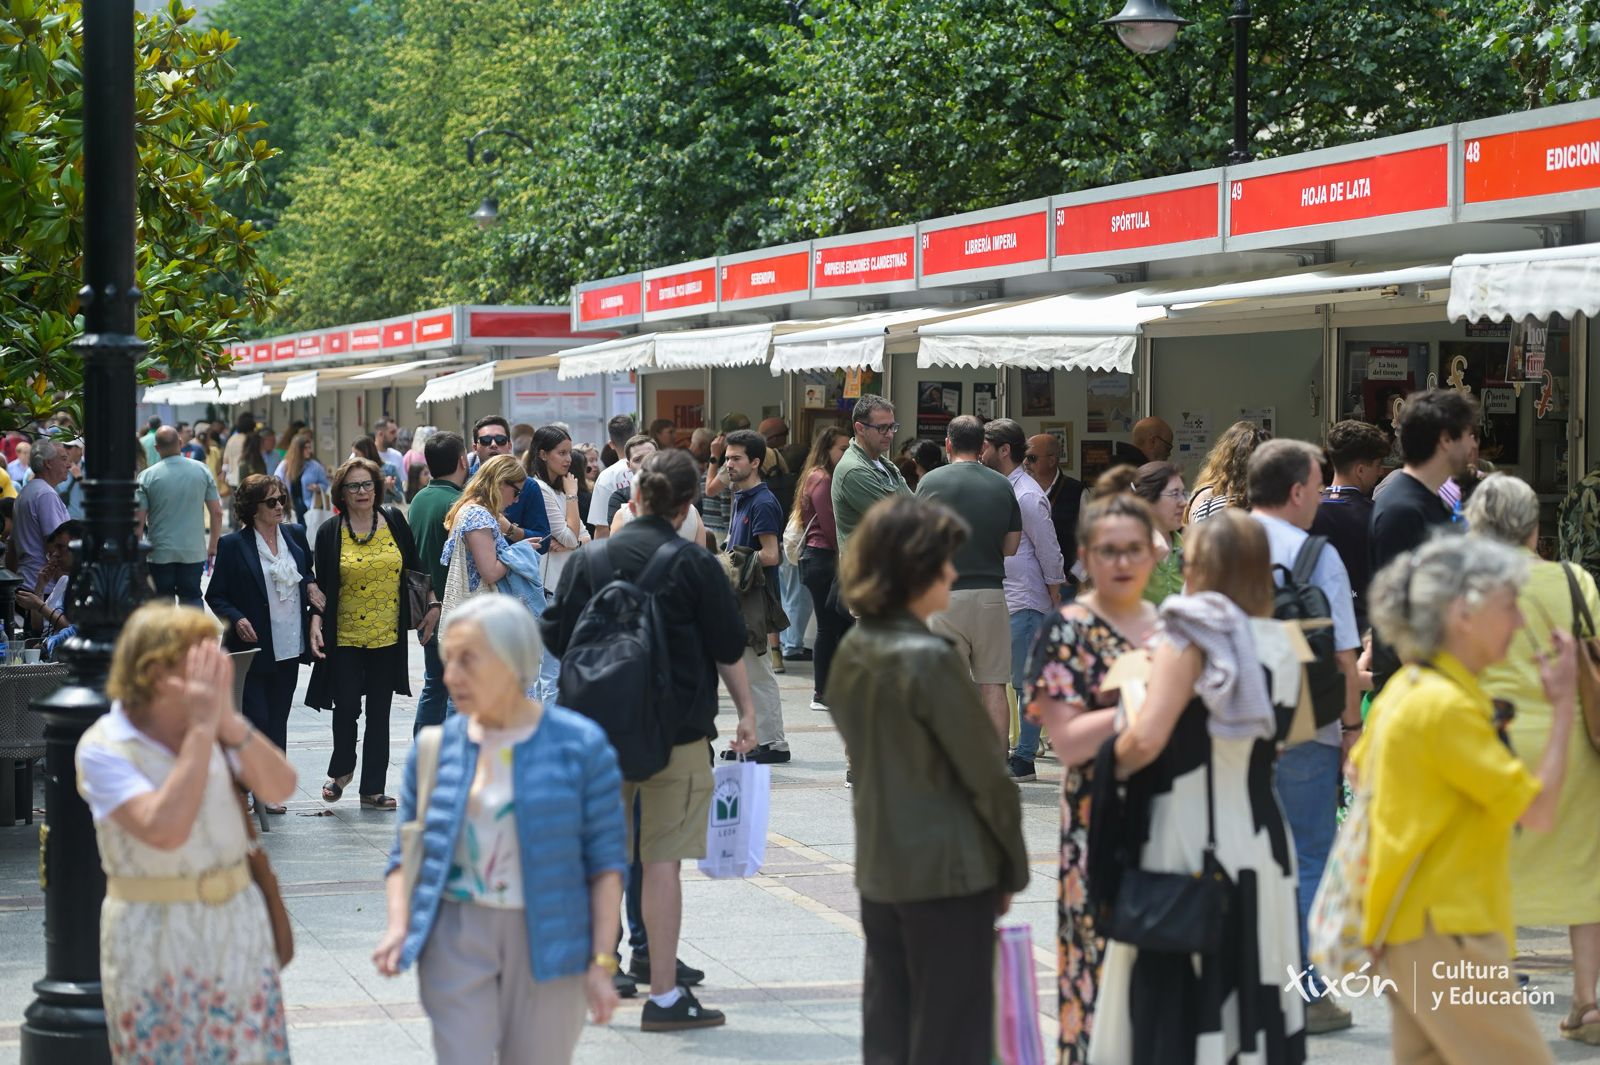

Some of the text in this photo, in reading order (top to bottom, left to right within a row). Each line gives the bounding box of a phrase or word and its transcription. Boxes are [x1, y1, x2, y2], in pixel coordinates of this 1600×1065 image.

[1466, 141, 1480, 162] 48
[1232, 183, 1242, 200] 49
[1301, 178, 1371, 207] HOJA DE LATA
[1057, 210, 1065, 226] 50
[1111, 211, 1150, 232] SPÓRTULA
[923, 234, 930, 249] 51
[965, 233, 1017, 255] LIBRERÍA IMPERIA
[845, 258, 871, 274] EDICIONES
[870, 252, 908, 271] CLANDESTINAS
[1387, 362, 1398, 370] hija
